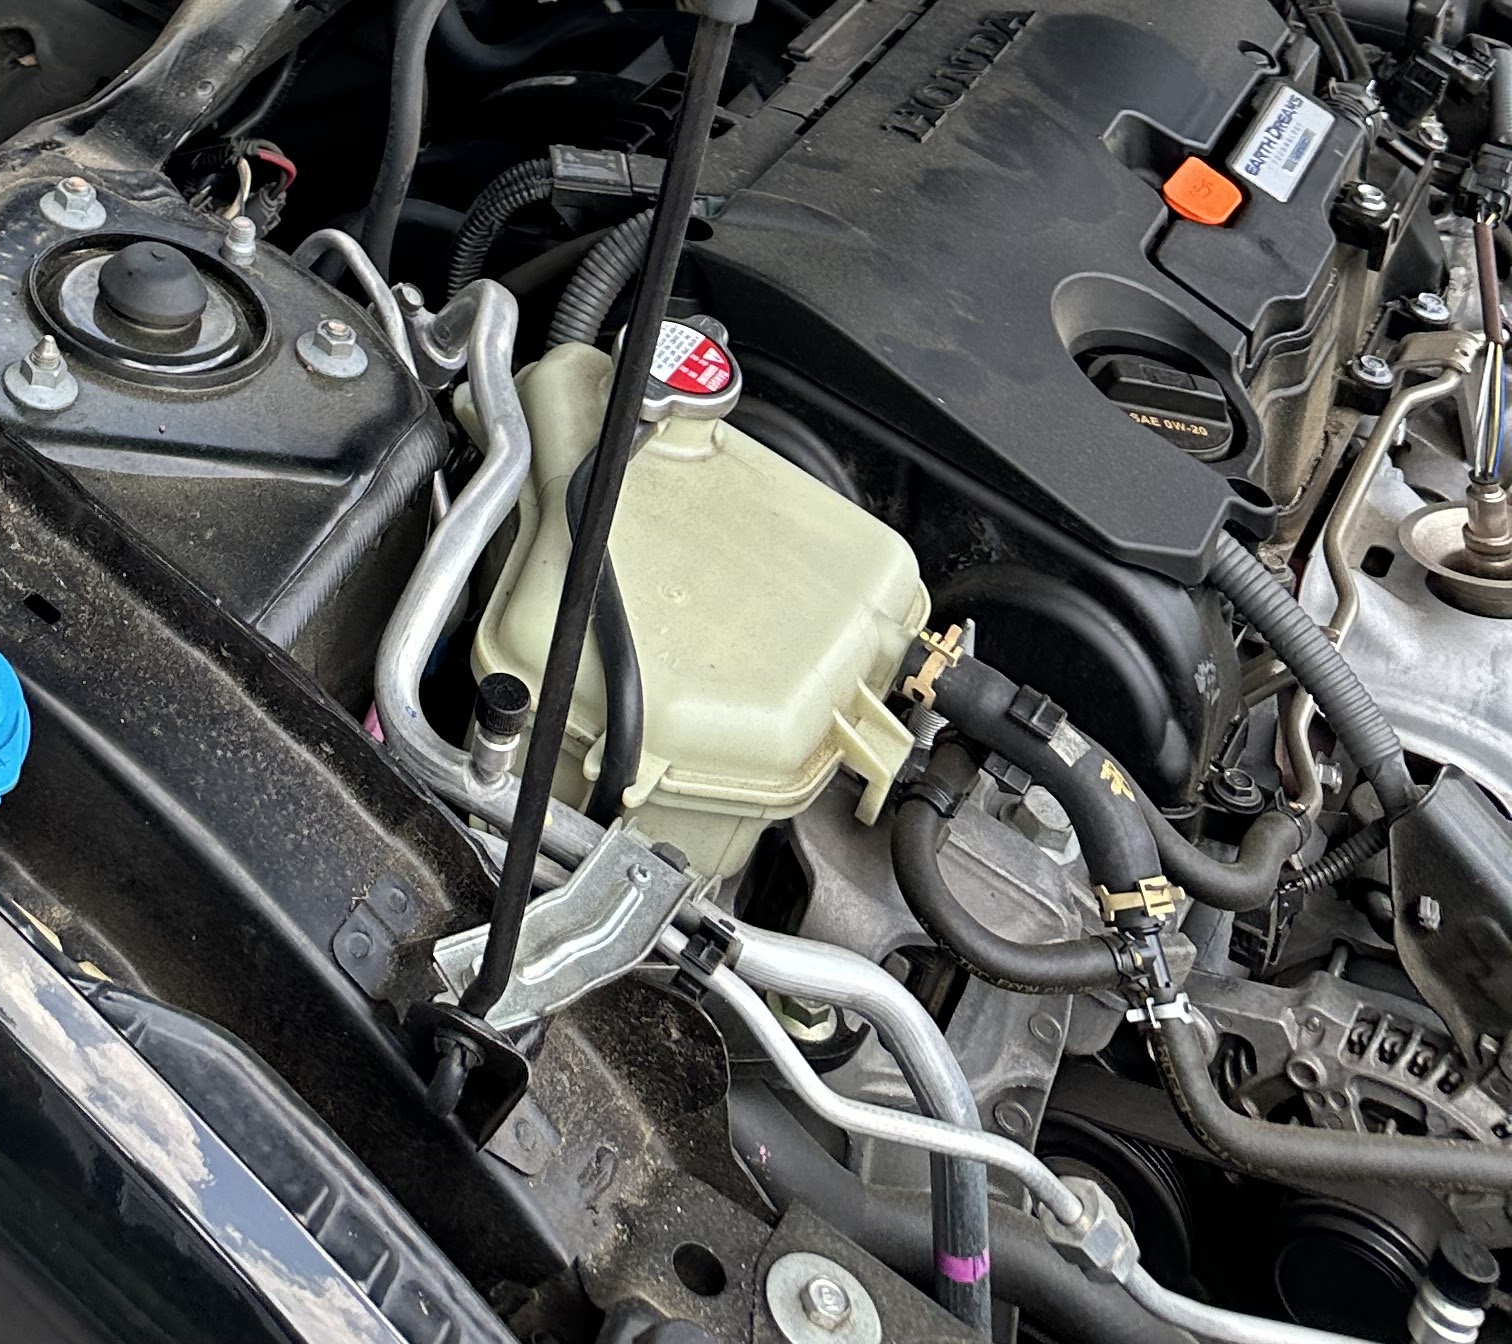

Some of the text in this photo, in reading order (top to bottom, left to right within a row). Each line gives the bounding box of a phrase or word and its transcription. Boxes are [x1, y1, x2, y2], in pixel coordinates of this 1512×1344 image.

[880, 11, 1036, 144] HONDA
[1244, 135, 1277, 176] EARTH
[1265, 94, 1305, 141] DREAMS
[1129, 412, 1208, 437] SAE 0W-20
